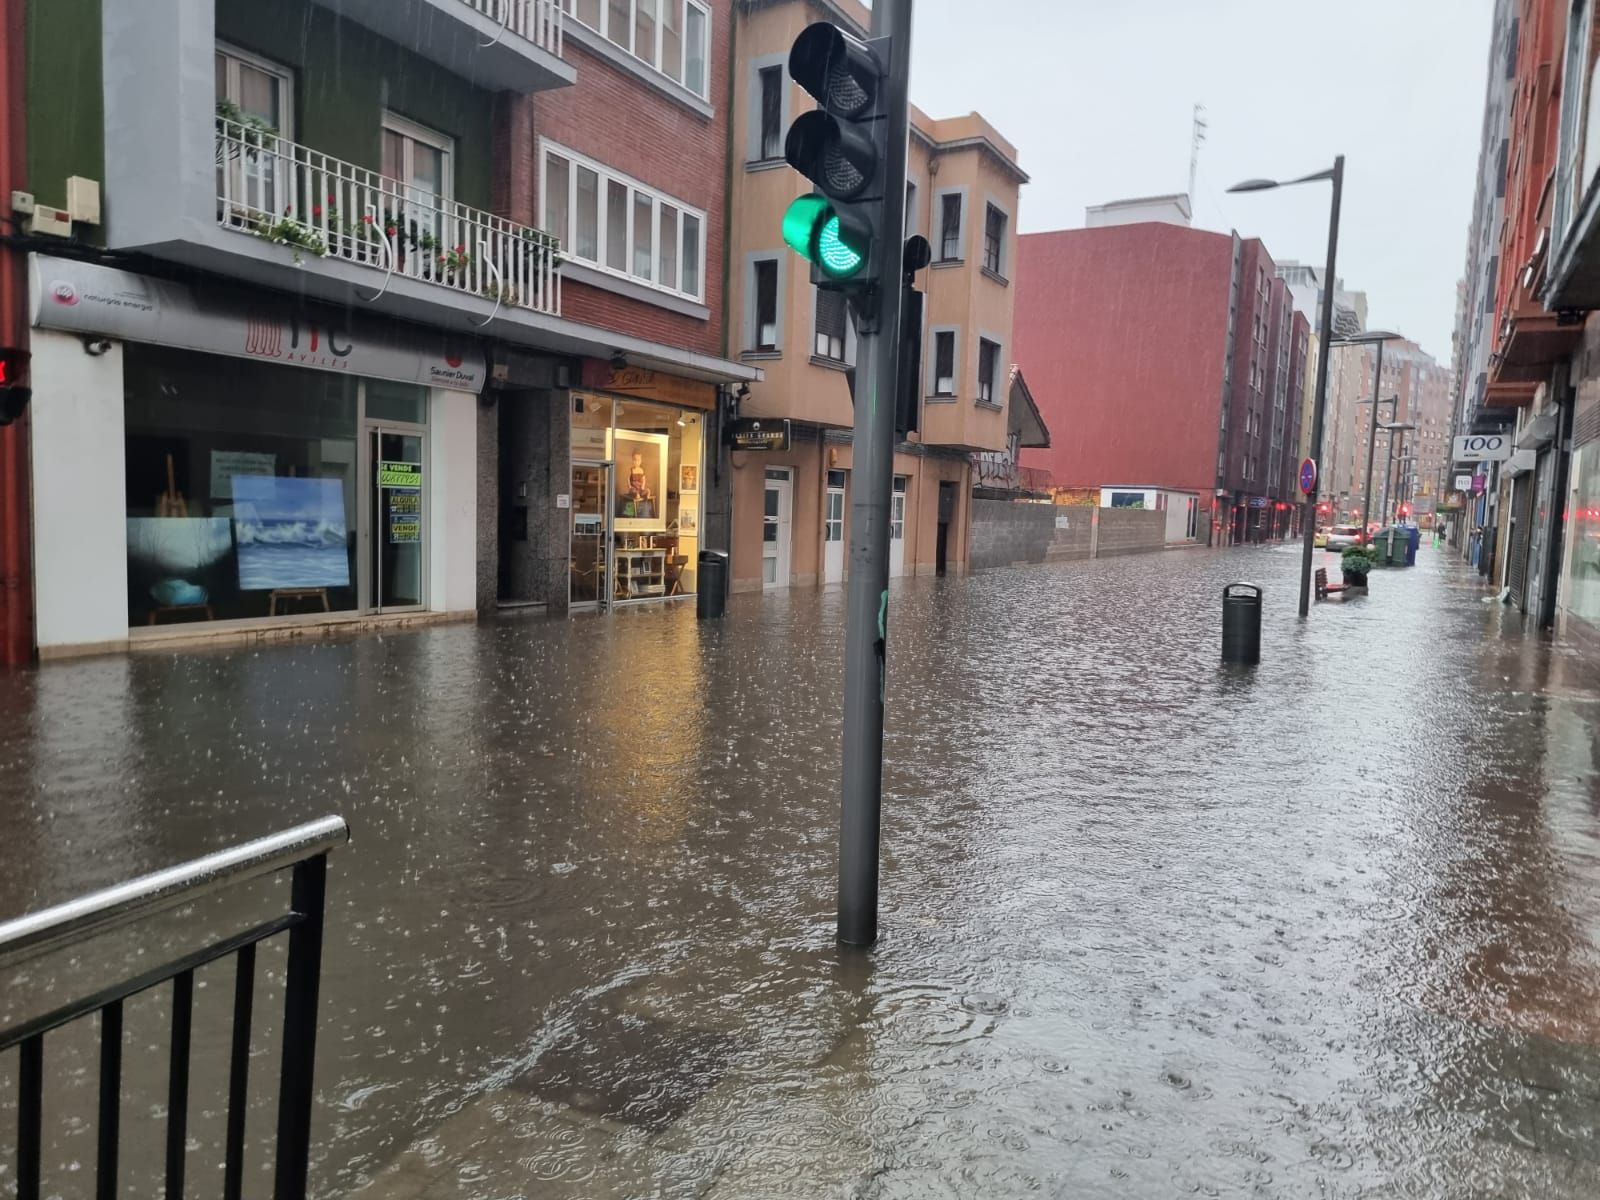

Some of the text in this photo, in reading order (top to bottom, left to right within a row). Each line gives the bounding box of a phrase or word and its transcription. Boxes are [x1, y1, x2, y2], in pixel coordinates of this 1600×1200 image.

[456, 370, 475, 382] Duval
[1464, 437, 1502, 450] 100
[389, 464, 412, 472] VENDE
